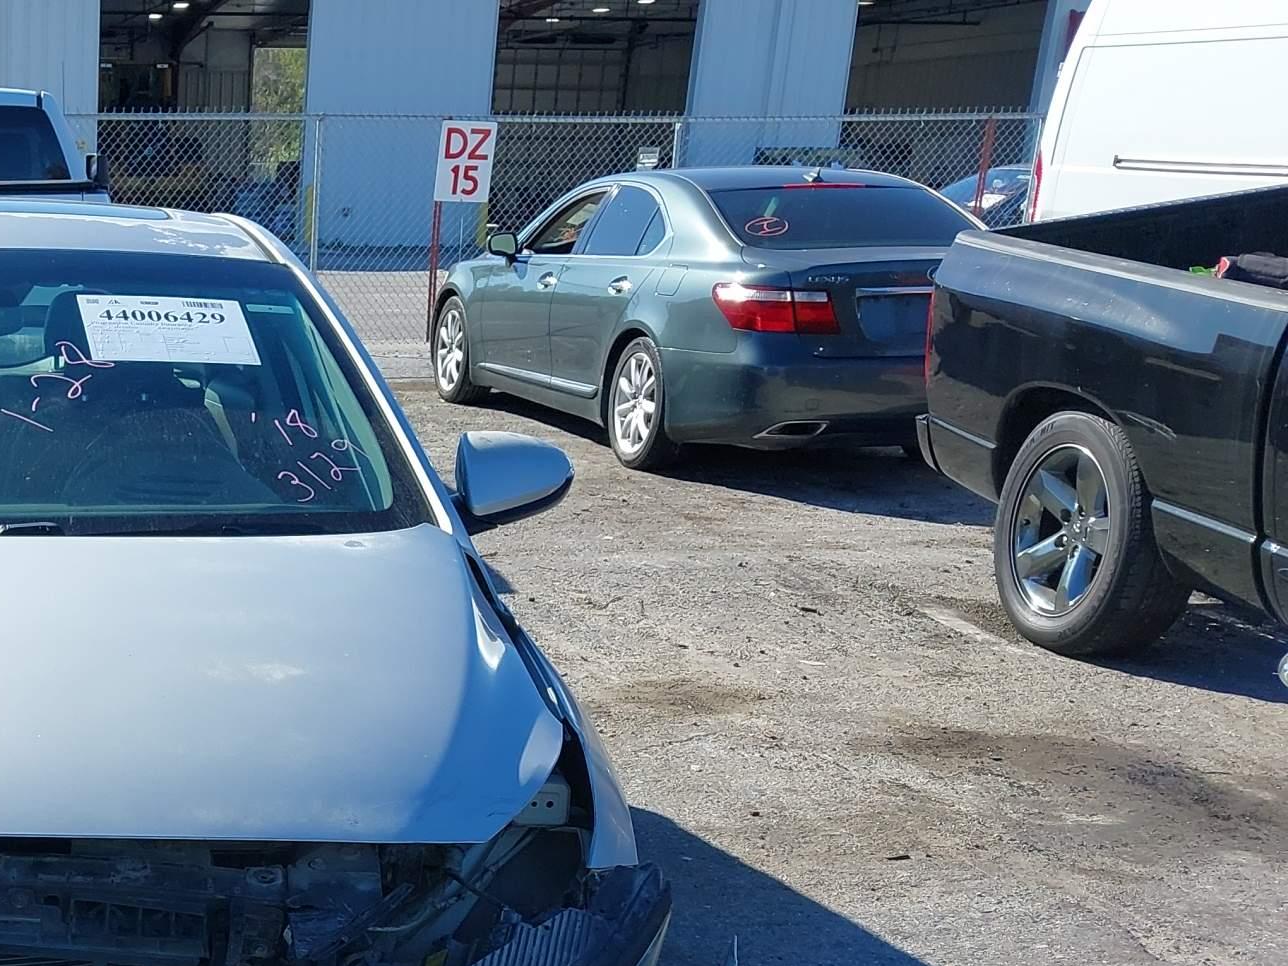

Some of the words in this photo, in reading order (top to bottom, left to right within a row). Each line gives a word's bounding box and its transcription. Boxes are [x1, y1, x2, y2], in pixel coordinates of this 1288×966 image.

[444, 127, 492, 160] DZ
[450, 164, 479, 196] 15
[99, 309, 226, 324] 44006429
[277, 439, 371, 503] 3129
